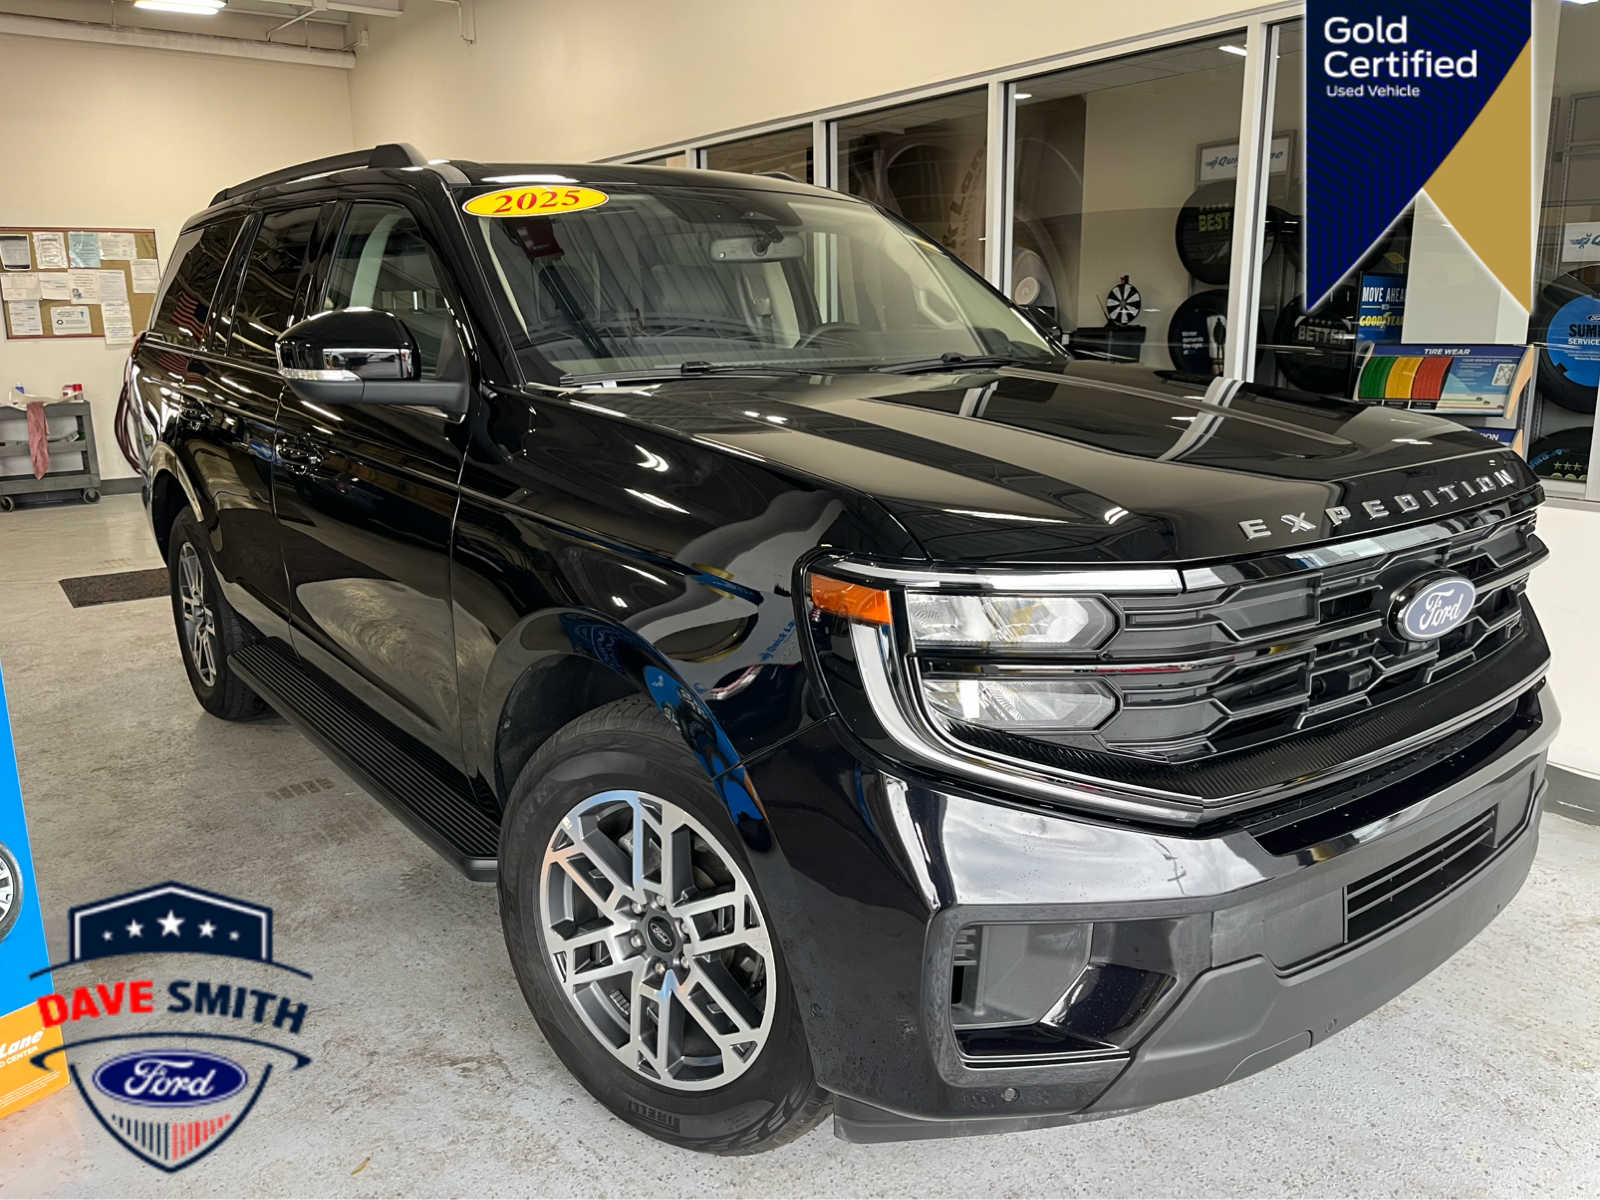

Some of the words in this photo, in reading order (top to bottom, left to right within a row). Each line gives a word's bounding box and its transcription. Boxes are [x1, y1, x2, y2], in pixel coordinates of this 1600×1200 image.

[493, 190, 581, 213] 2025
[1198, 212, 1232, 231] BEST
[1362, 286, 1384, 302] MOVE
[1385, 287, 1405, 303] AHEA
[1298, 326, 1347, 345] BETTER
[1568, 323, 1600, 337] SUM
[1237, 468, 1516, 541] EXPEDITION
[1419, 589, 1464, 631] Ford
